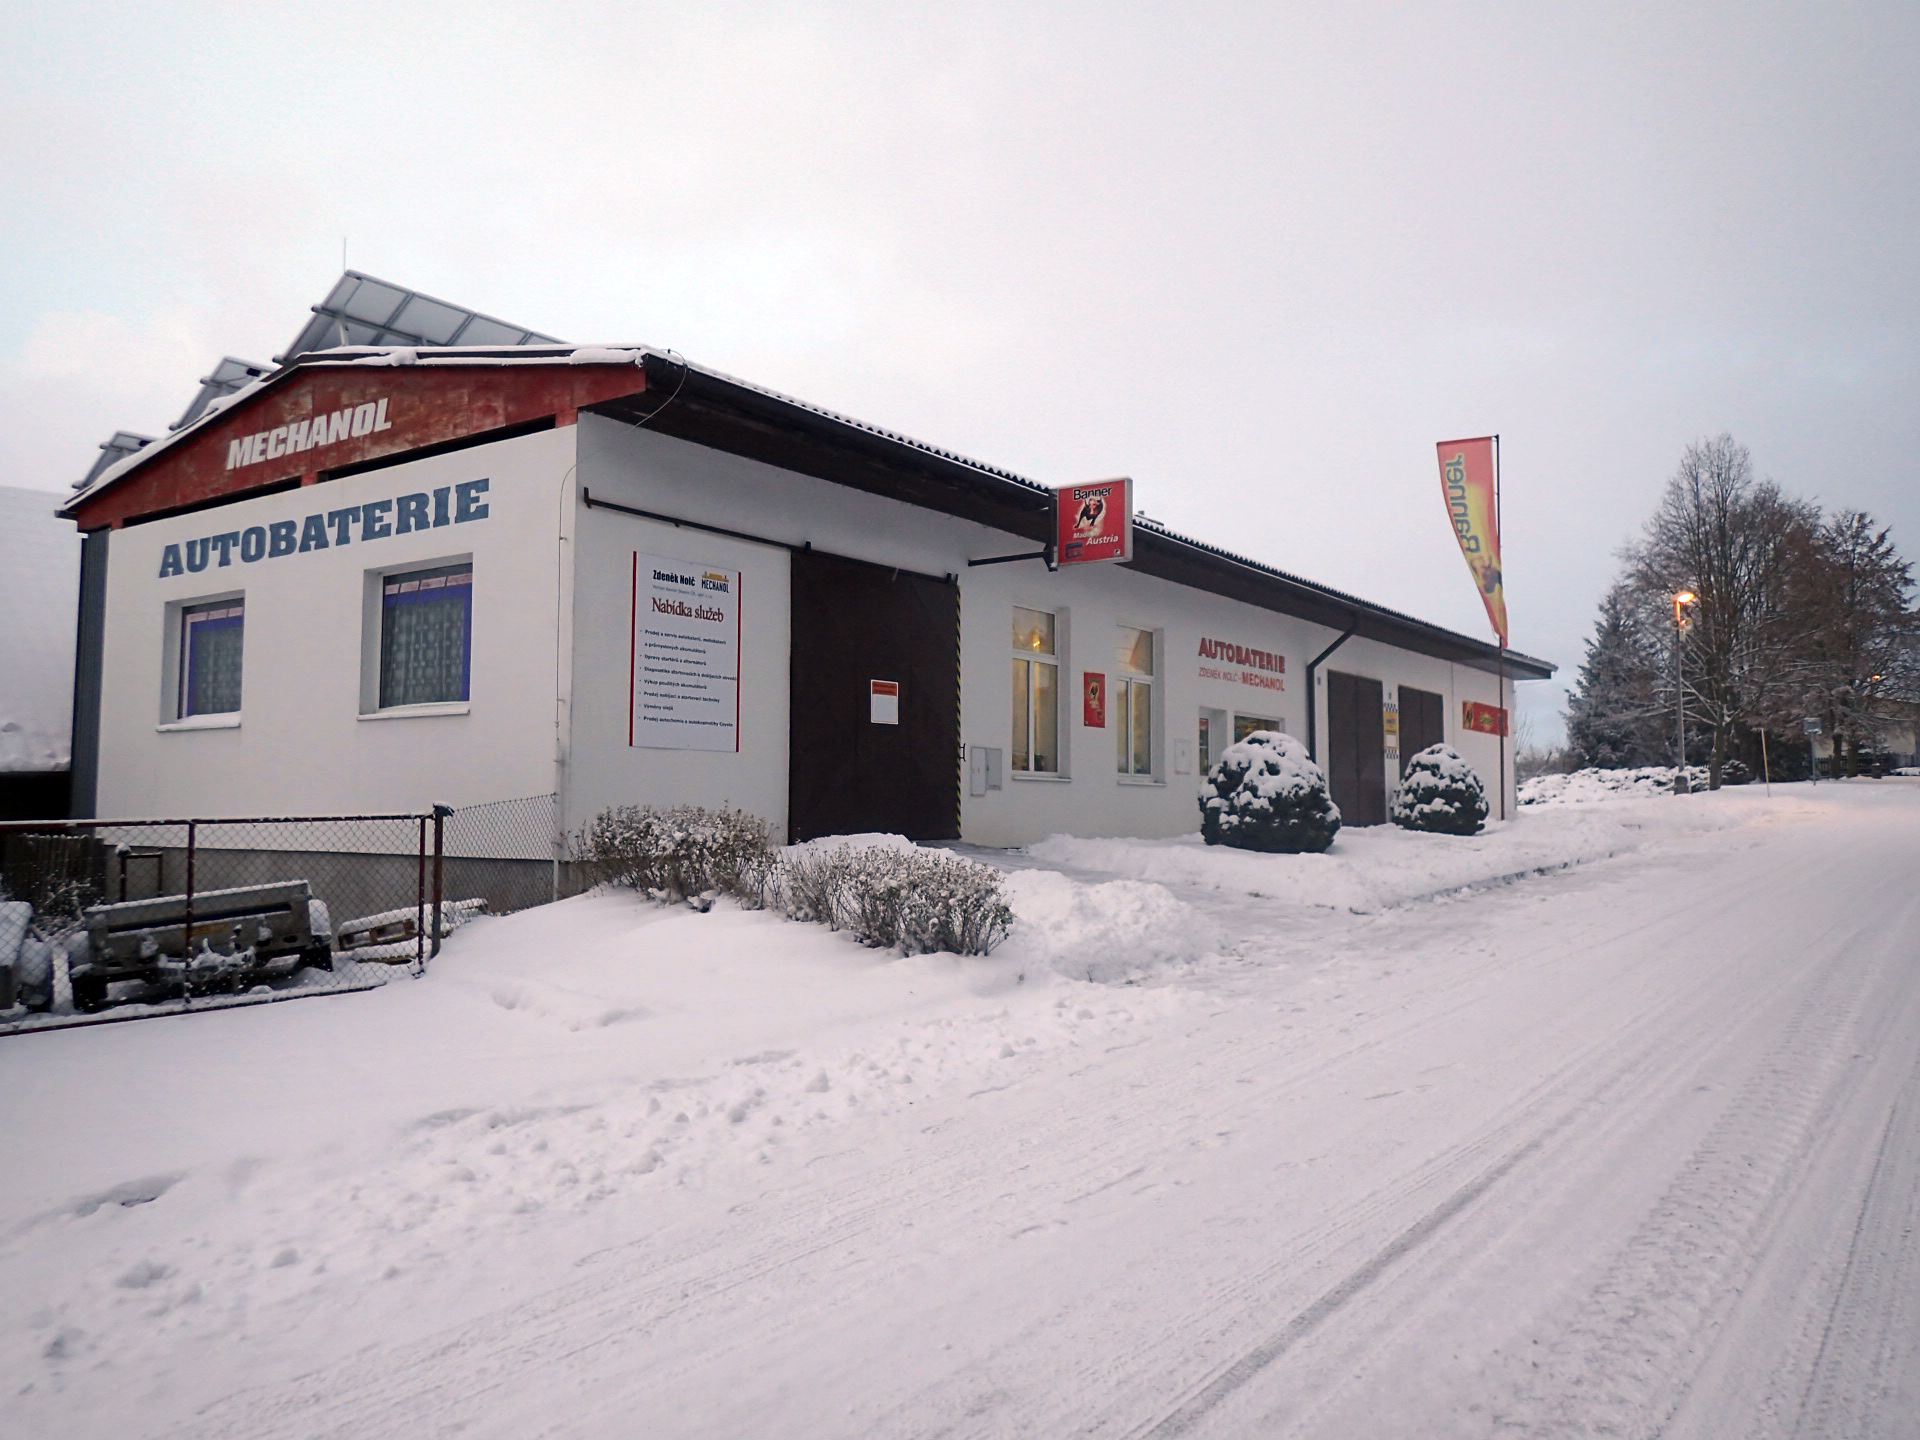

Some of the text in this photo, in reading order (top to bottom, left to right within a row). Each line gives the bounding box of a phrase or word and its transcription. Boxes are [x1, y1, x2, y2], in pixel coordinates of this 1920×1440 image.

[226, 398, 392, 470] MECHANOL
[1073, 487, 1112, 500] Banner
[158, 478, 490, 578] AUTOBATERIE
[1086, 534, 1119, 545] Austria
[653, 570, 695, 587] Zdeněk Nolč
[702, 579, 730, 594] MECHANOL
[652, 597, 724, 623] Nabídka služeb
[1198, 637, 1286, 673] AUTOBATERIE
[1242, 672, 1285, 691] MECHANOL
